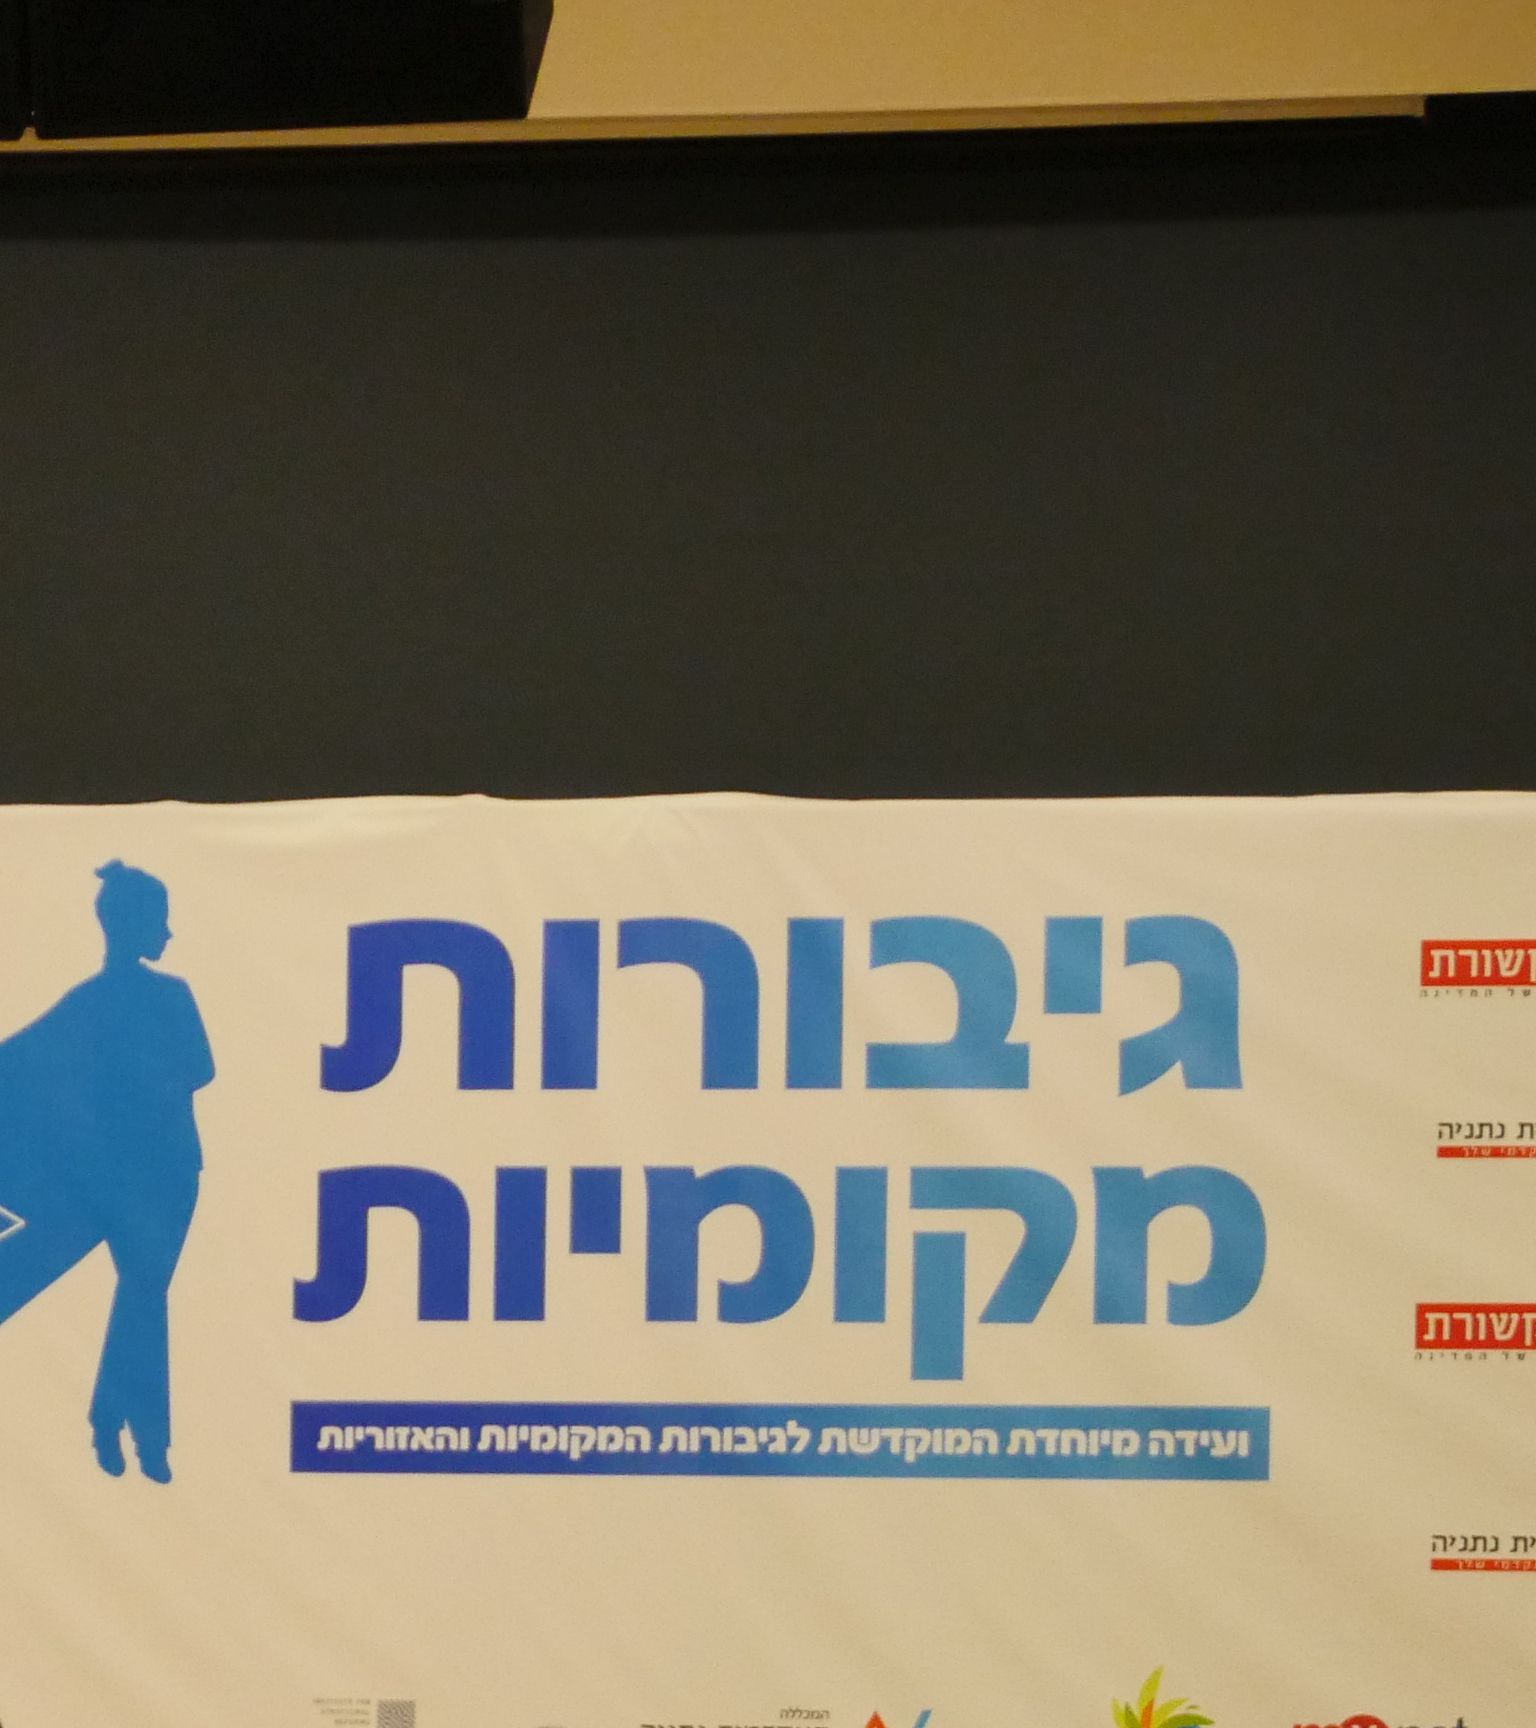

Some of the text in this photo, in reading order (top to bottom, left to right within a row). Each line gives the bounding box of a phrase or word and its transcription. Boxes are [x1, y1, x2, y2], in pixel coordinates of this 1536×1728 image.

[1428, 948, 1536, 982] שורת
[319, 914, 1243, 1096] גיבורות
[1437, 1121, 1506, 1140] נתניה
[292, 1164, 1267, 1380] מקומיות
[1422, 1312, 1536, 1347] קשורת
[316, 1419, 1250, 1463] ועידה מיוחדת המוקדשת לגיבורות המקומיות והאזוריות
[1431, 1534, 1500, 1553] נתניה
[779, 1708, 830, 1720] המכללה
